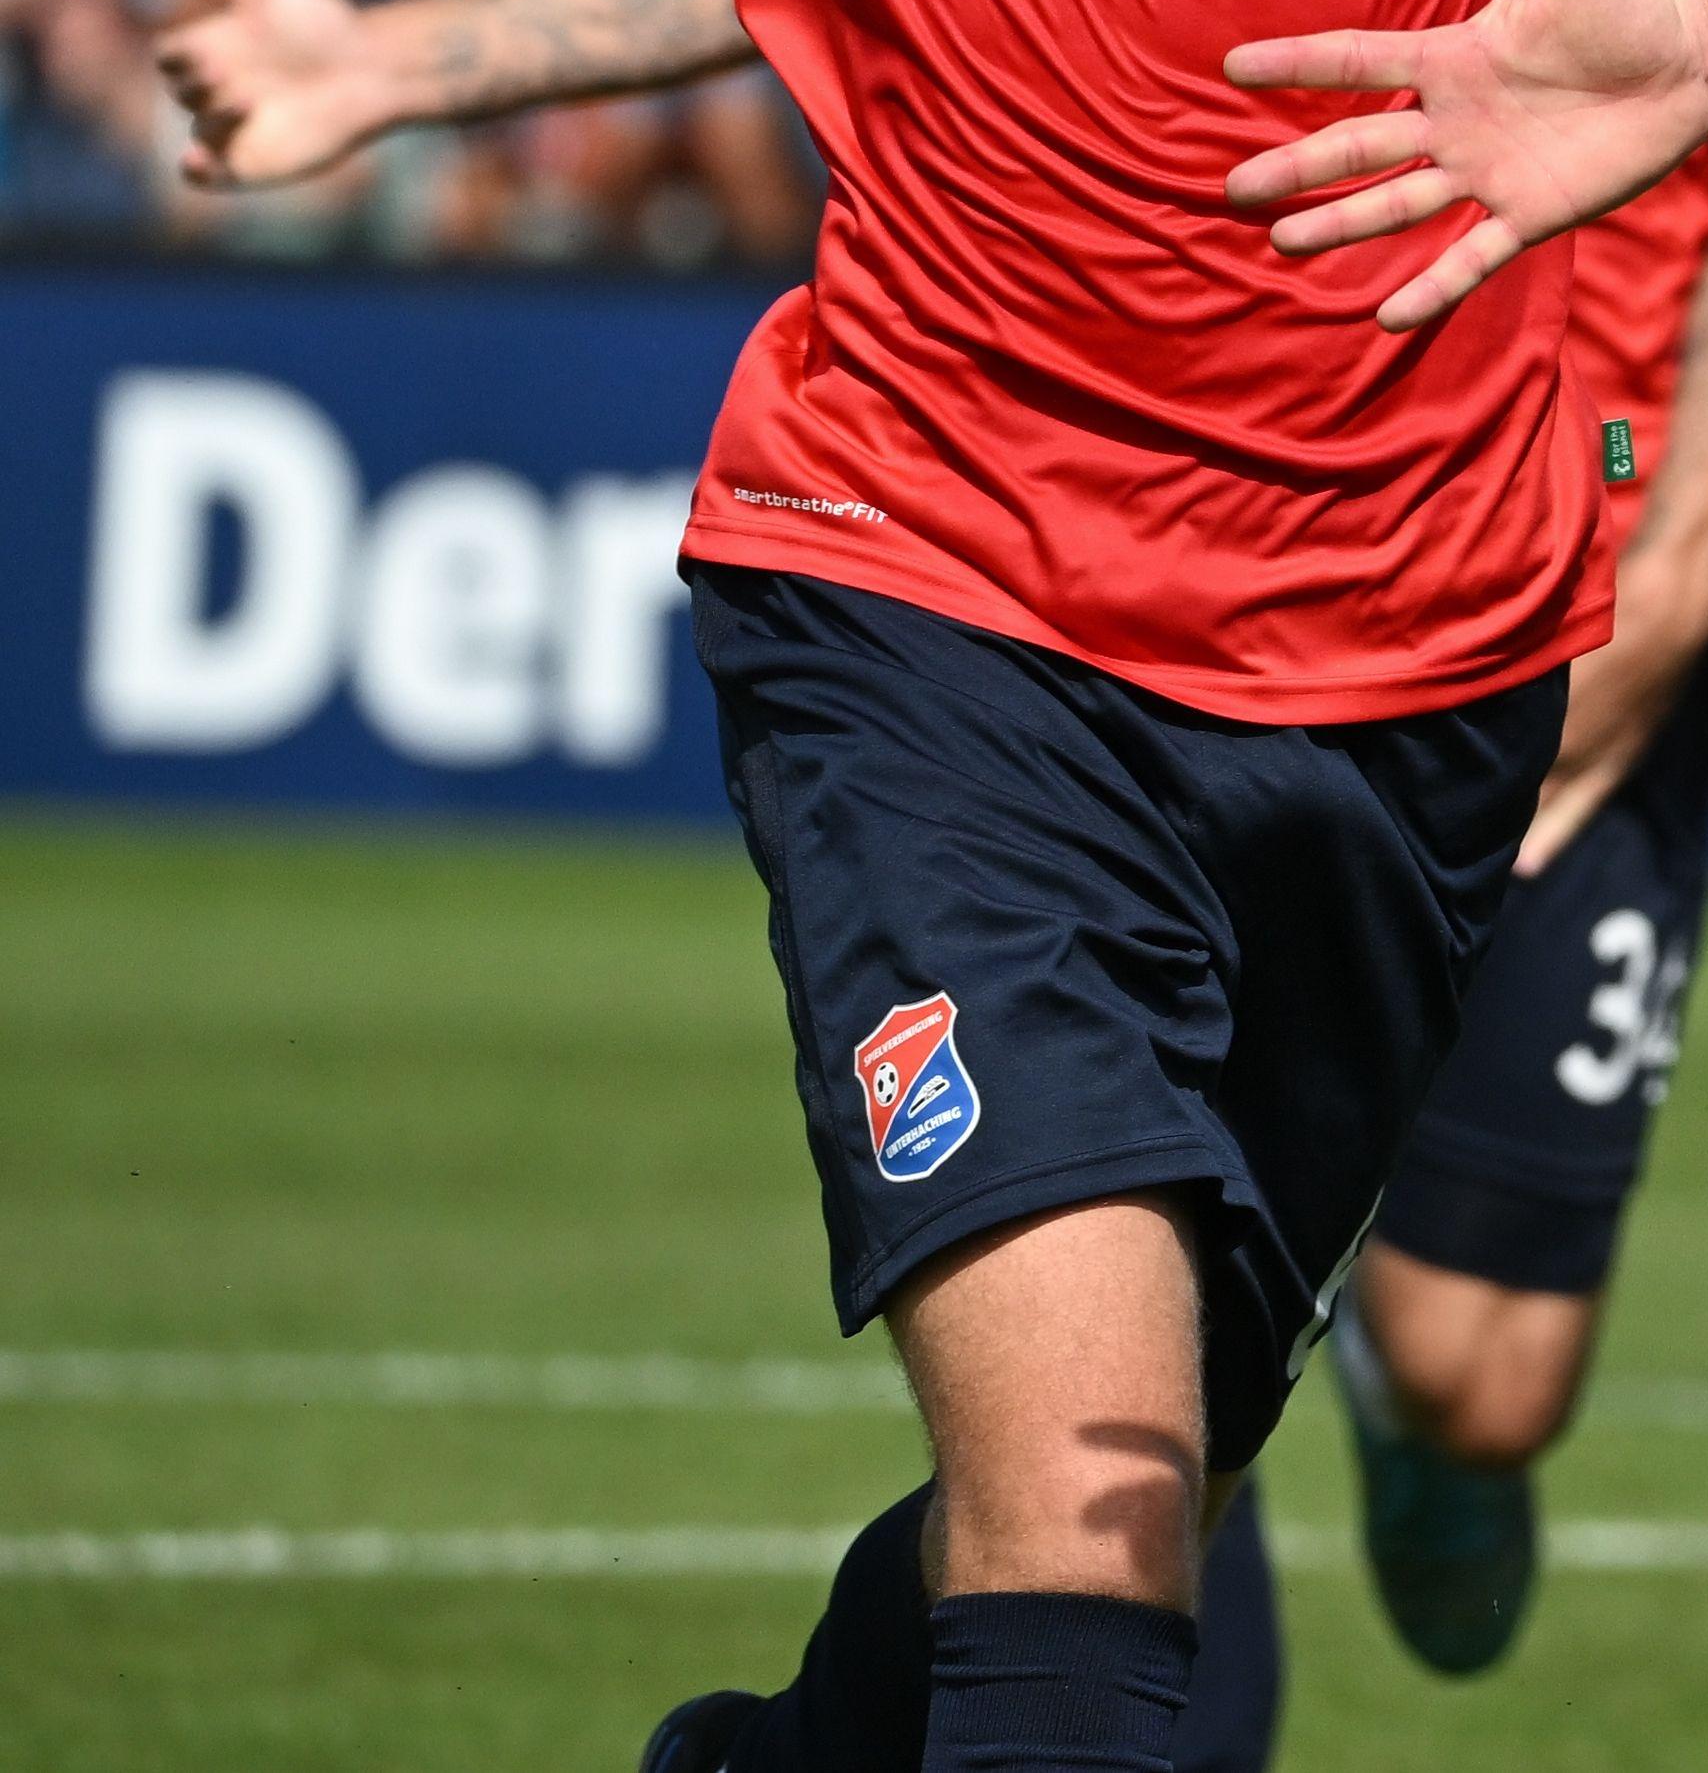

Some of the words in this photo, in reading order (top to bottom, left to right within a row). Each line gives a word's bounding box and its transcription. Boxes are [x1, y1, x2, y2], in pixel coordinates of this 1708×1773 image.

[90, 367, 701, 770] Der
[863, 1009, 945, 1068] SPIELVEREINIGUNG
[885, 1105, 963, 1160] UNTERHACHING
